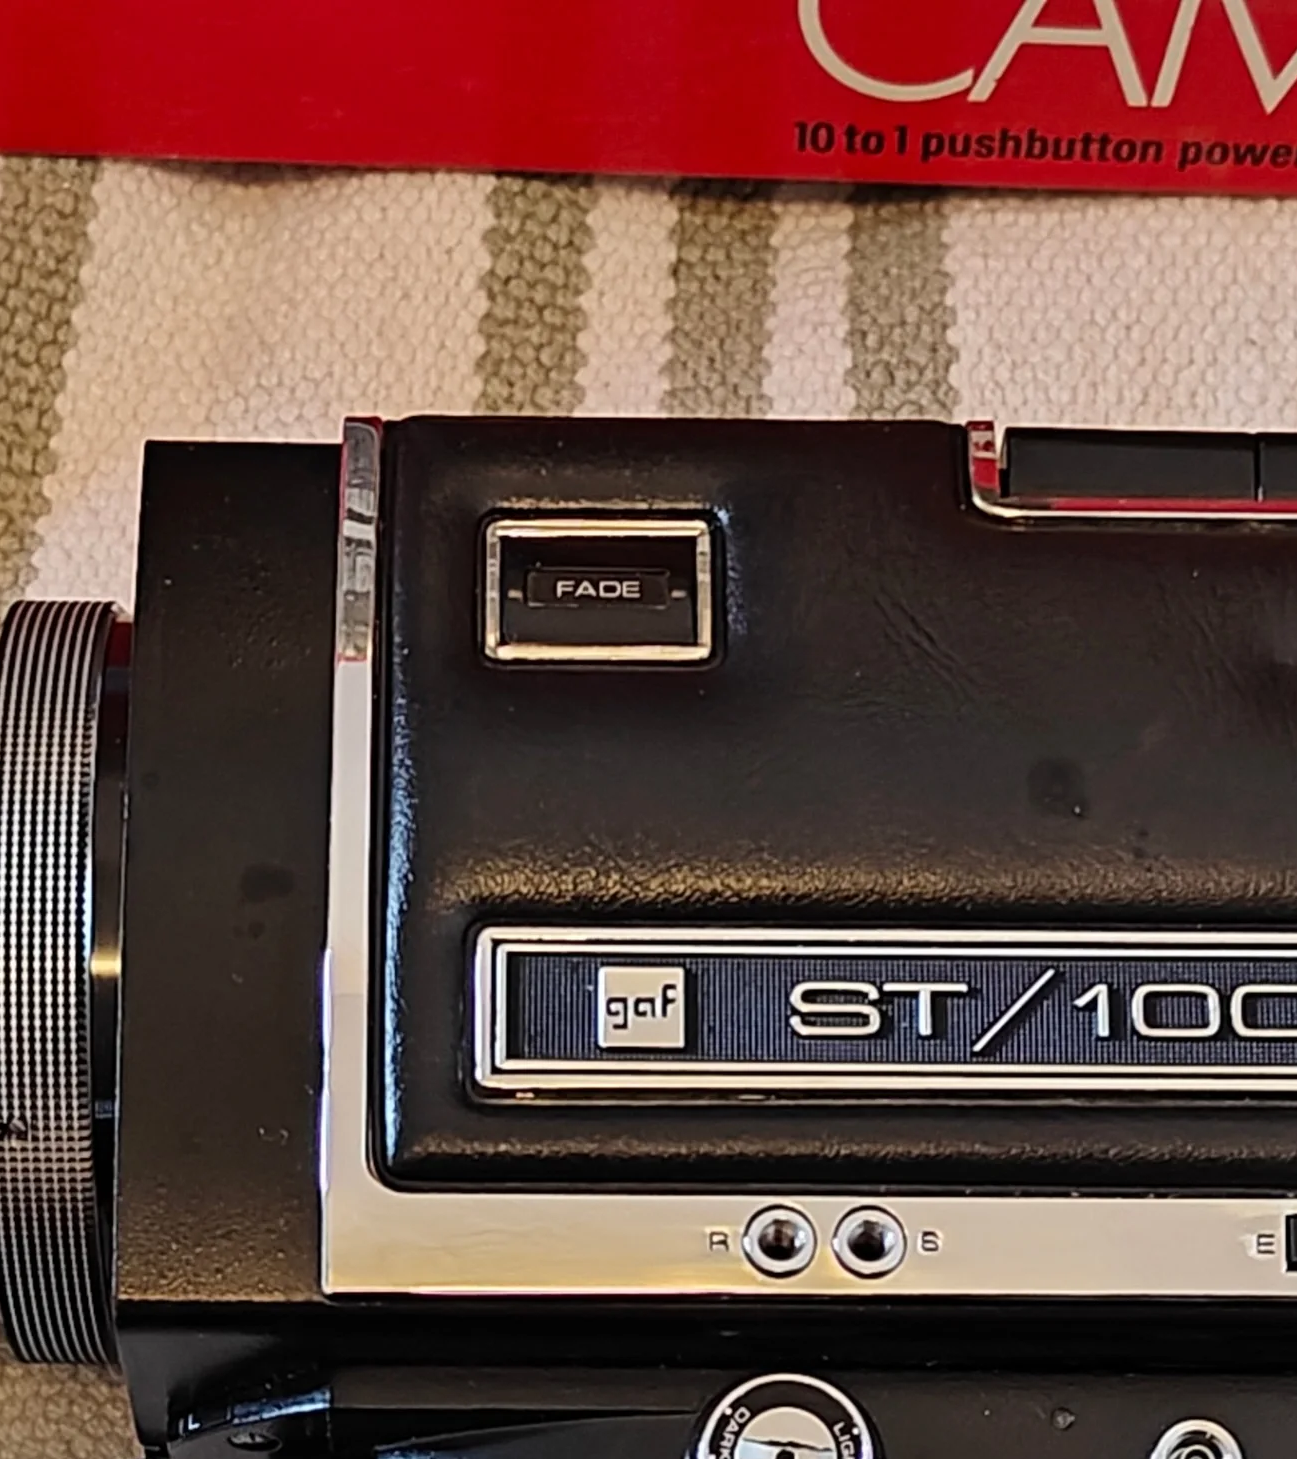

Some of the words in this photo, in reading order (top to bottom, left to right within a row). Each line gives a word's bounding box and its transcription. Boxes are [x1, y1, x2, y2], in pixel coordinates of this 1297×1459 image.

[794, 121, 834, 155] 10
[844, 124, 885, 156] to
[894, 127, 909, 157] 1
[920, 127, 1164, 164] pushbutton
[555, 579, 641, 599] FADE
[605, 983, 677, 1030] gaf
[709, 1231, 729, 1251] R
[1257, 1233, 1275, 1254] E
